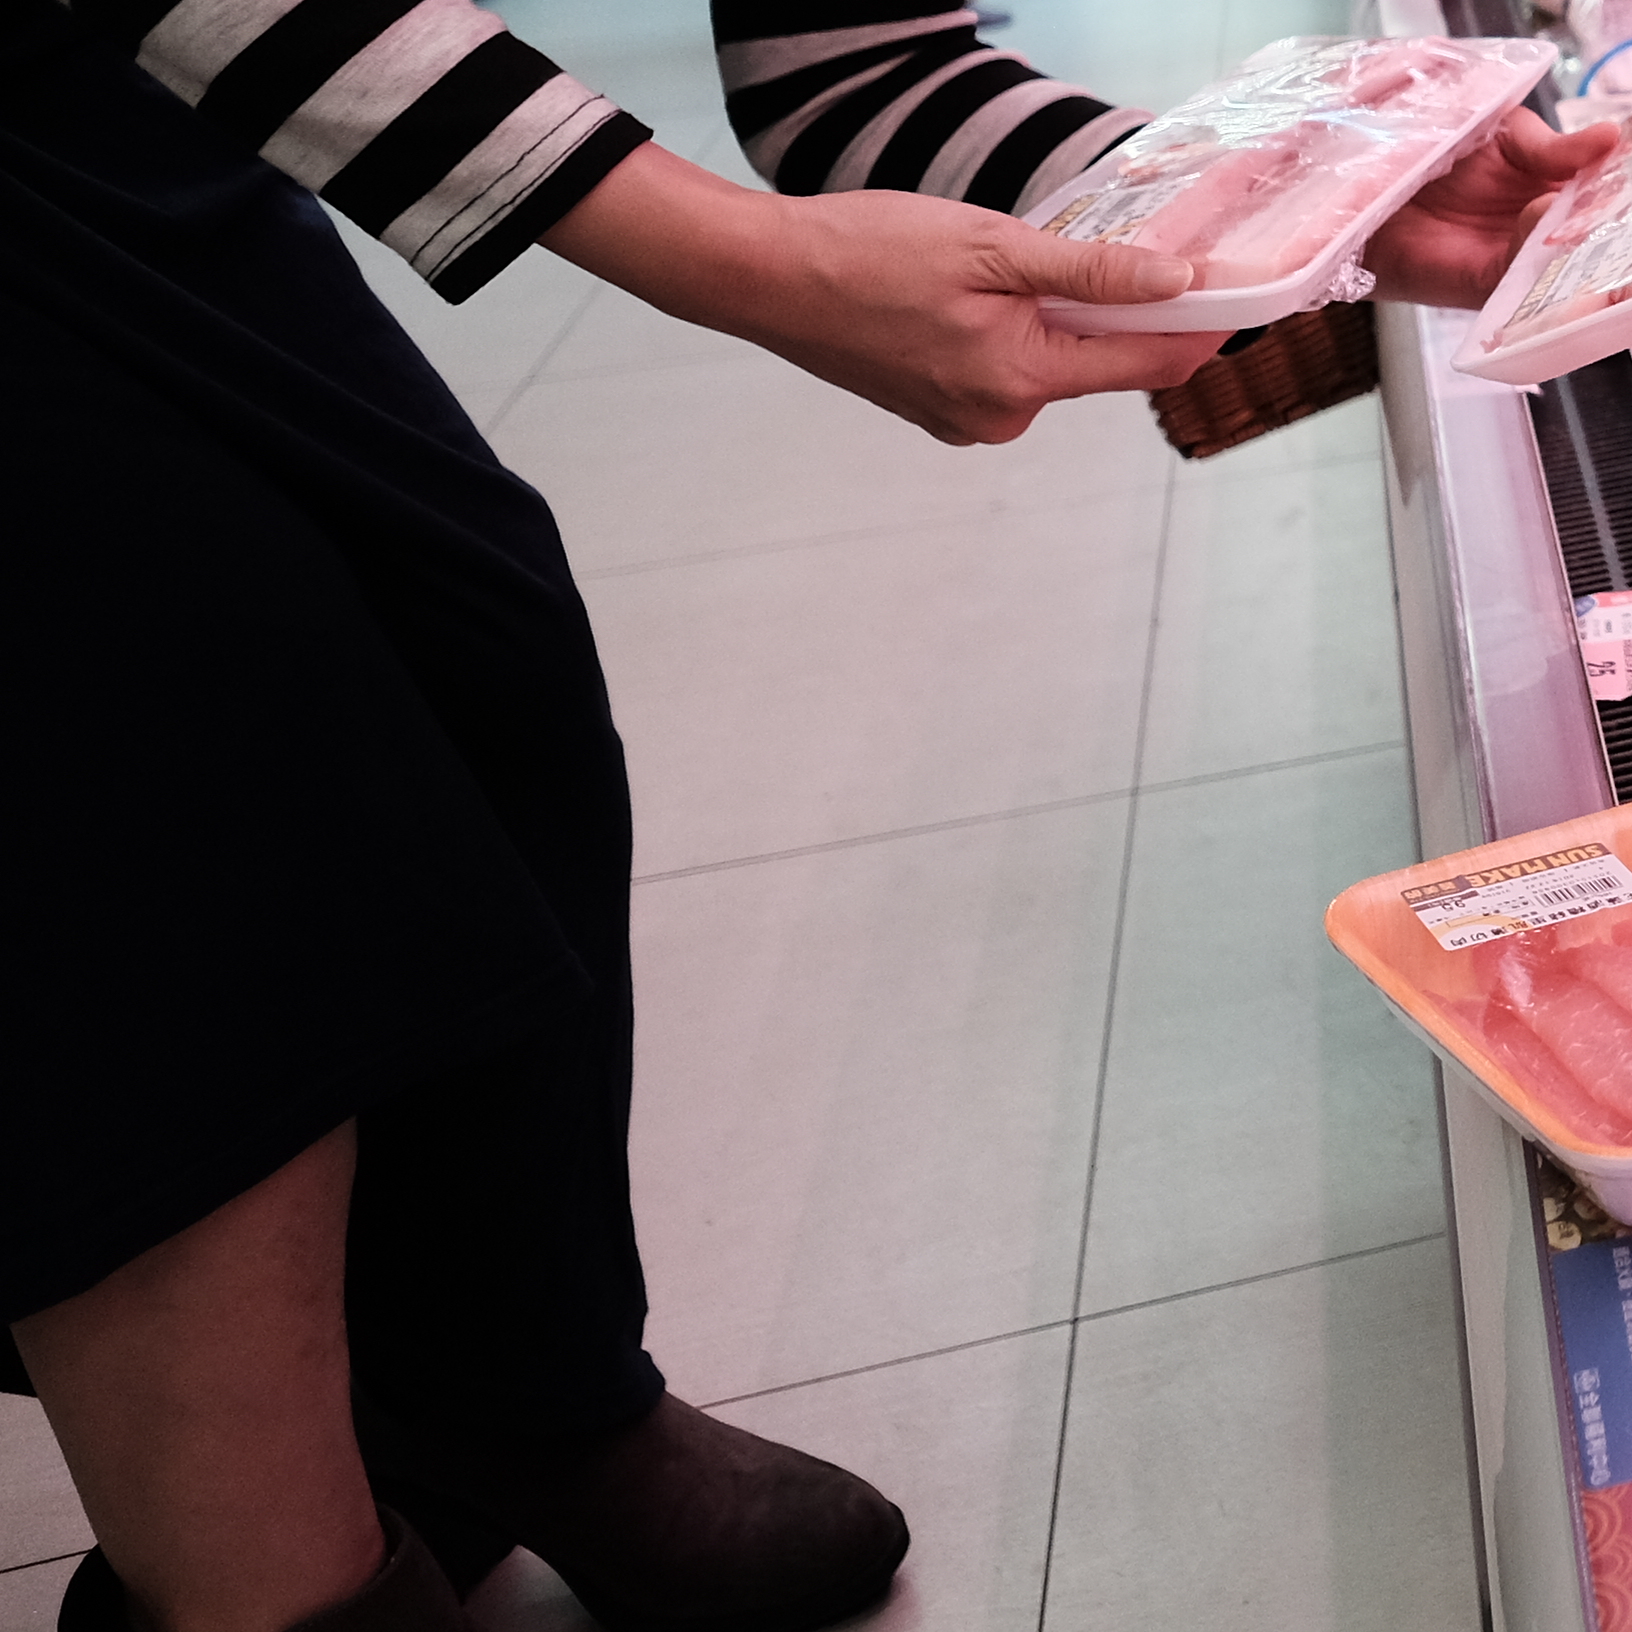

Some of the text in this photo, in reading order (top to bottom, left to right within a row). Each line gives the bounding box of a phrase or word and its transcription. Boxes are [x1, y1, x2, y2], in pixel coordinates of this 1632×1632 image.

[1546, 843, 1602, 866] SUN
[1464, 857, 1545, 886] MAKE
[1440, 899, 1465, 912] 95
